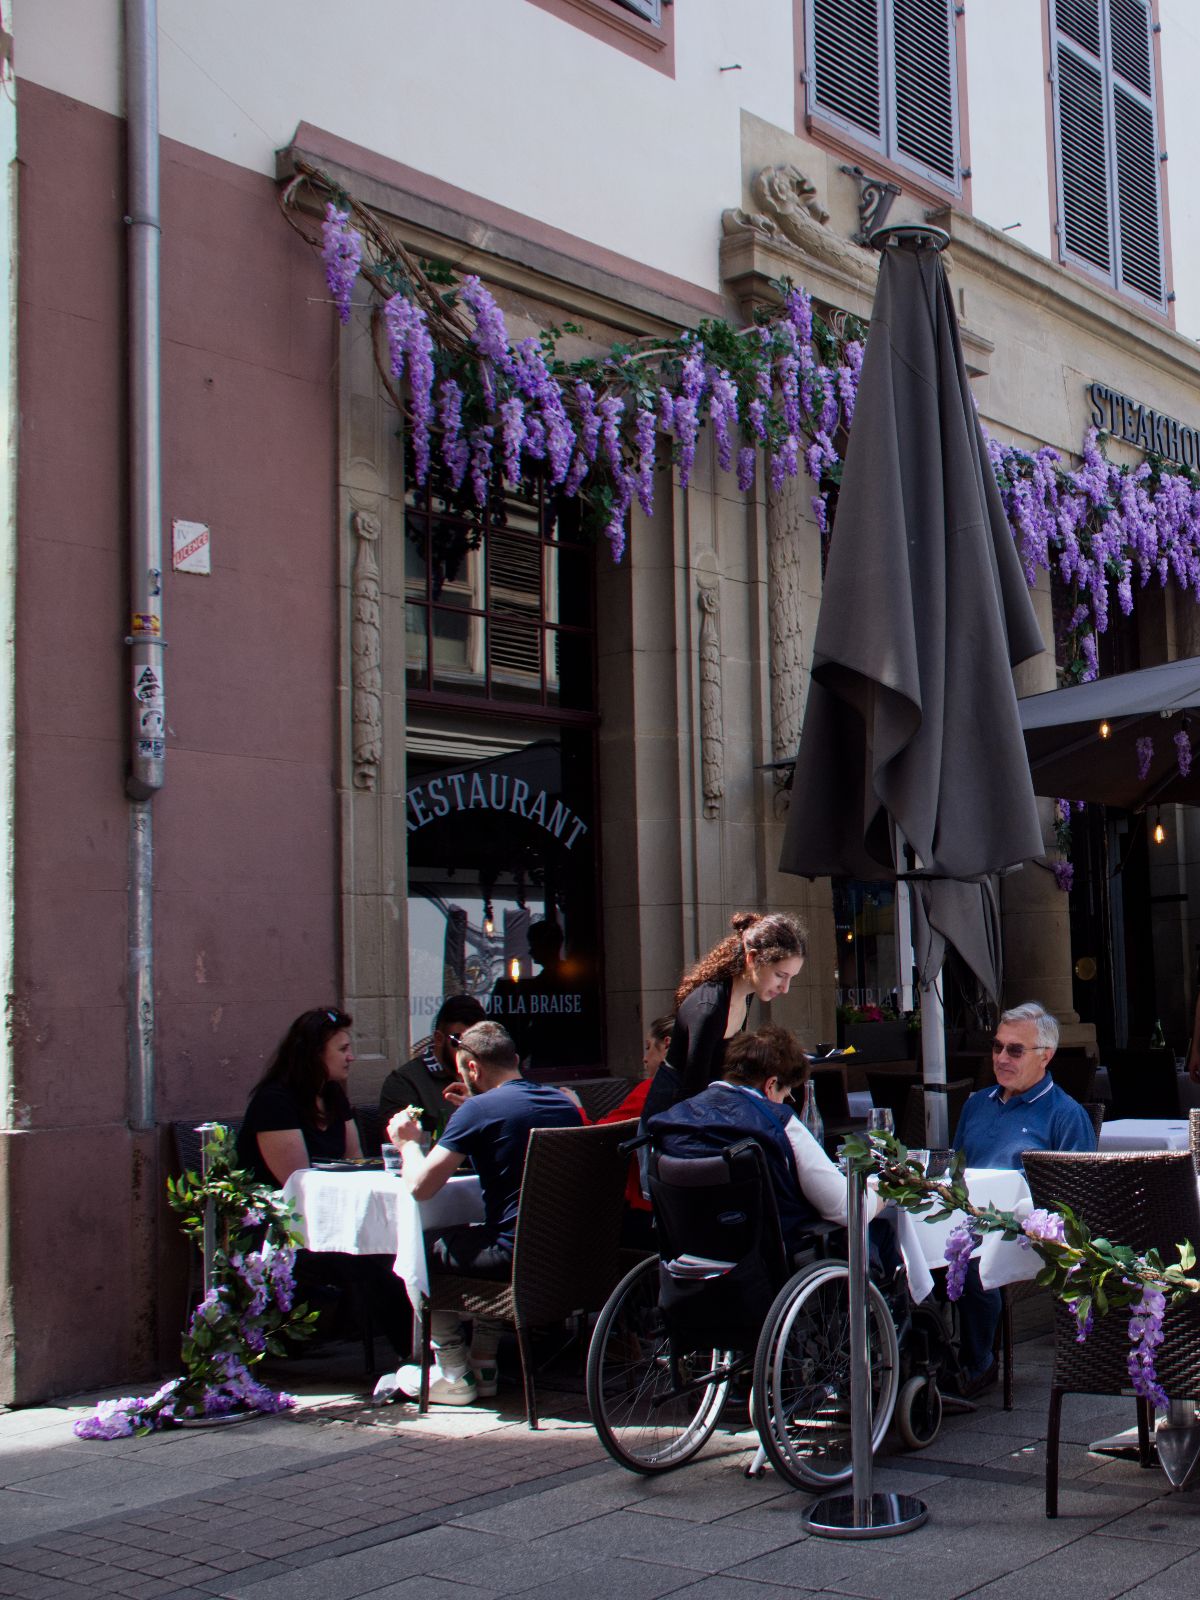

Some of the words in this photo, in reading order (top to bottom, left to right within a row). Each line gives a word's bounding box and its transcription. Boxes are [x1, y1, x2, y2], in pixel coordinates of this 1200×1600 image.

[175, 531, 209, 565] LICENCE
[406, 772, 588, 850] ESTAURANT
[508, 994, 527, 1014] LA
[530, 993, 582, 1013] BRAISE
